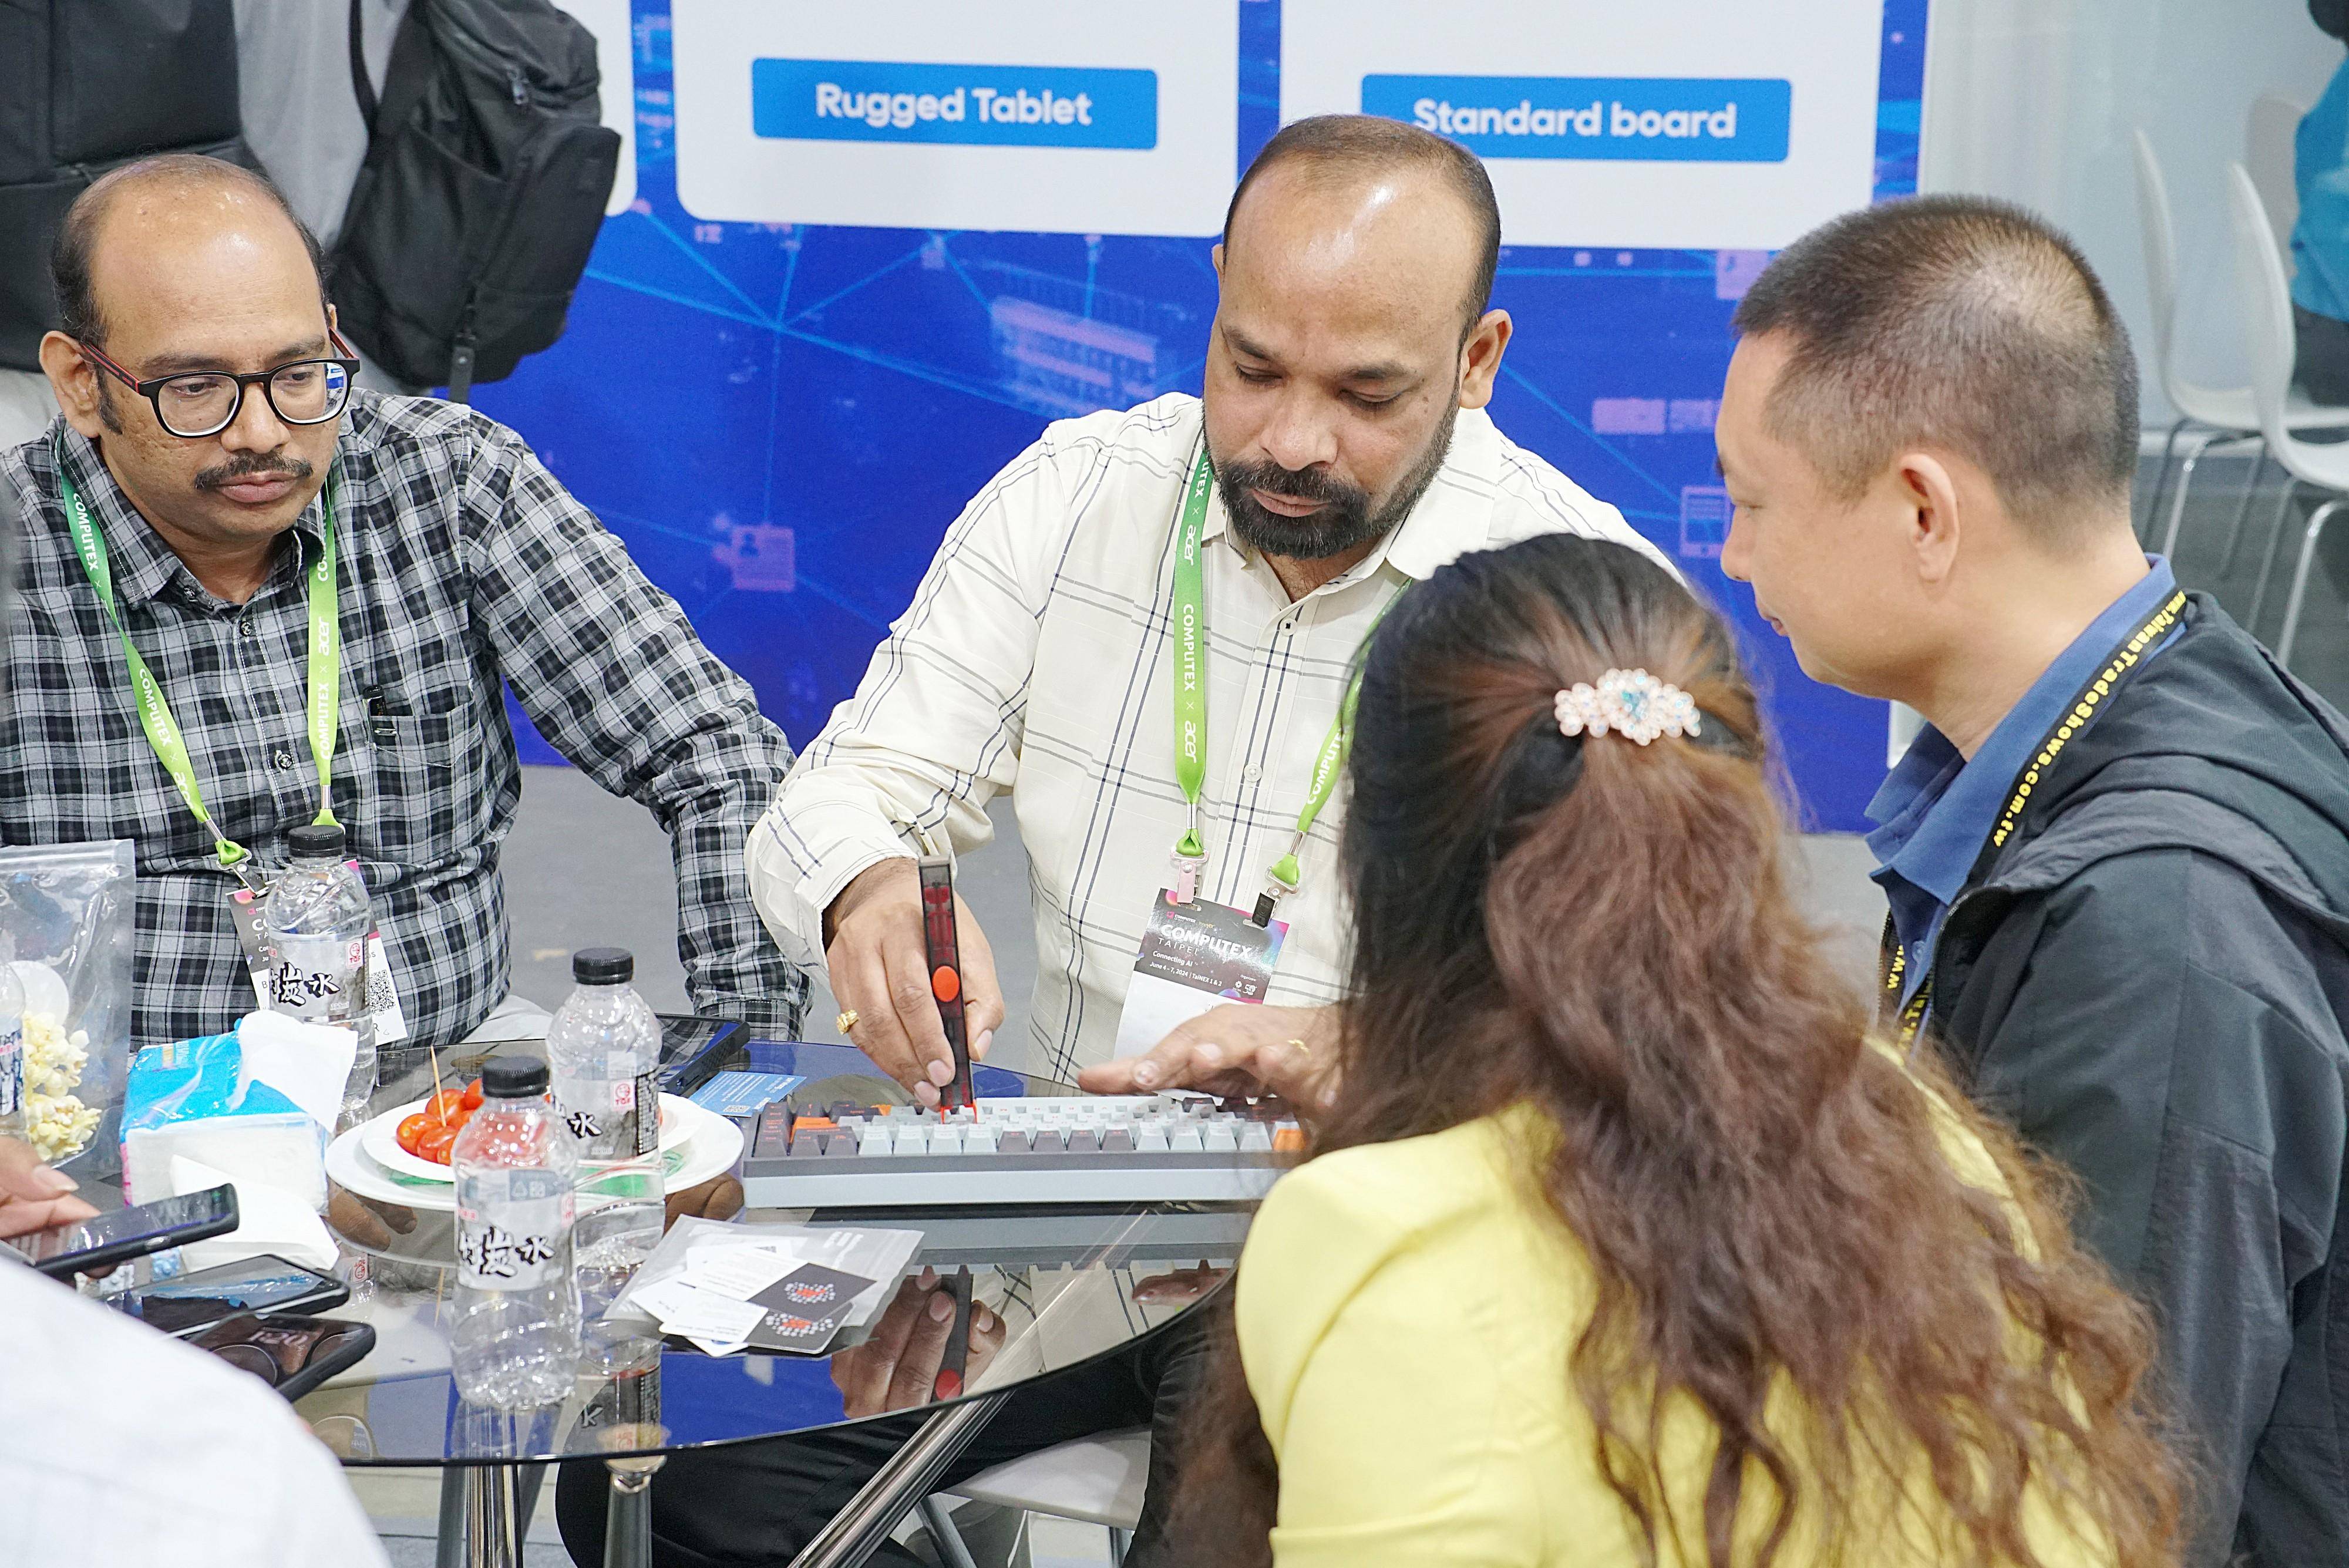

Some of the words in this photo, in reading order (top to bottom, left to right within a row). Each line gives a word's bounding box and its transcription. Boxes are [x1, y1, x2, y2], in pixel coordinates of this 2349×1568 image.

[816, 82, 965, 128] Rugged
[971, 86, 1092, 126] Tablet
[1414, 97, 1602, 136] Standard
[1611, 100, 1737, 138] board
[73, 493, 99, 571] COMPUTEX
[1184, 526, 1196, 566] acer
[318, 617, 329, 656] acer
[1183, 604, 1195, 692] COMPUTEX
[139, 668, 173, 747] COMPUTEX
[316, 682, 329, 760] COMPUTEX
[1184, 720, 1197, 763] acer
[1153, 951, 1184, 966] Connecting
[1158, 937, 1198, 955] TAIPEI
[1161, 924, 1252, 960] COMPUTEX
[1149, 961, 1163, 970] June
[1176, 969, 1189, 977] 2024
